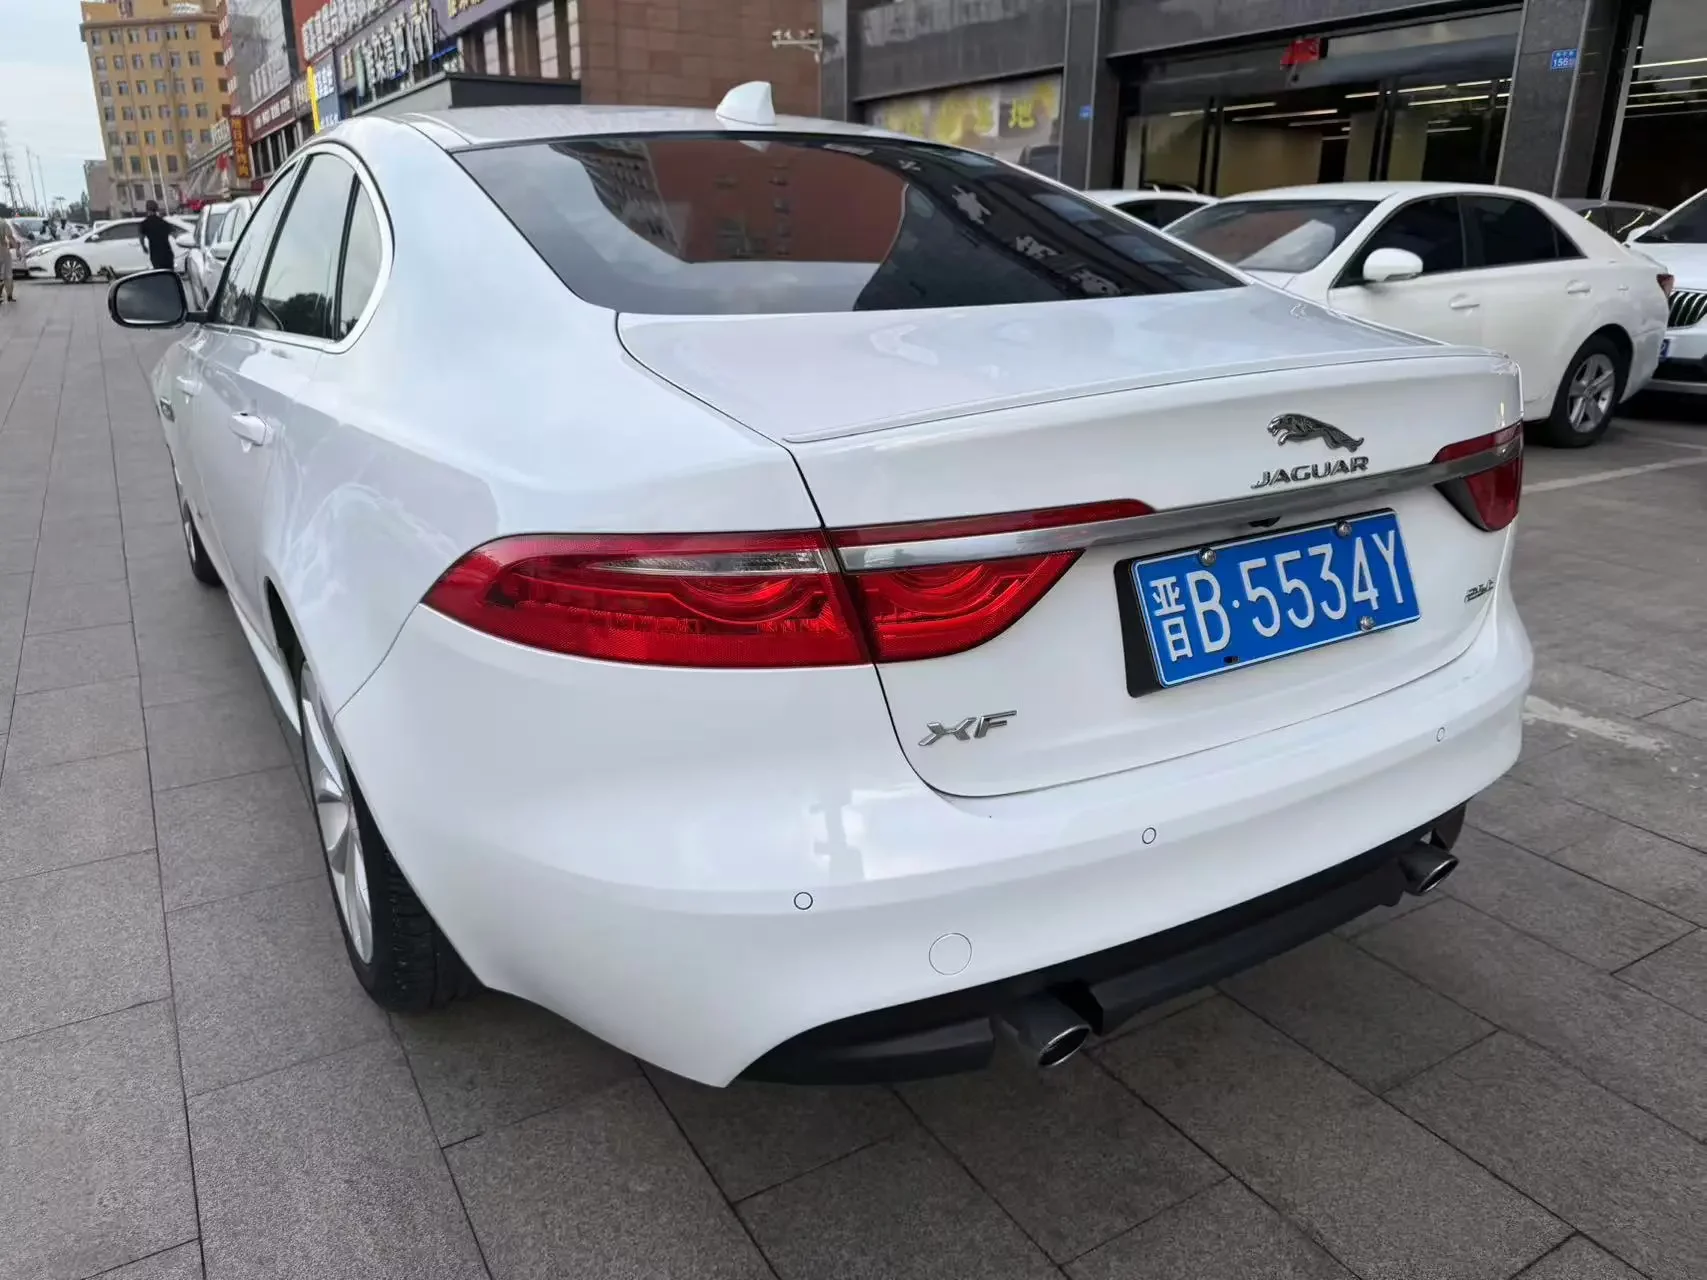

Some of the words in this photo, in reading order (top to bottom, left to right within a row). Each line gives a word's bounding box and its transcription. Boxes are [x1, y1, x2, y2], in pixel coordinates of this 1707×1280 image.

[1250, 456, 1369, 489] JAGUAR
[1149, 529, 1405, 662] 晋B·5534Y
[918, 709, 1018, 746] XF
